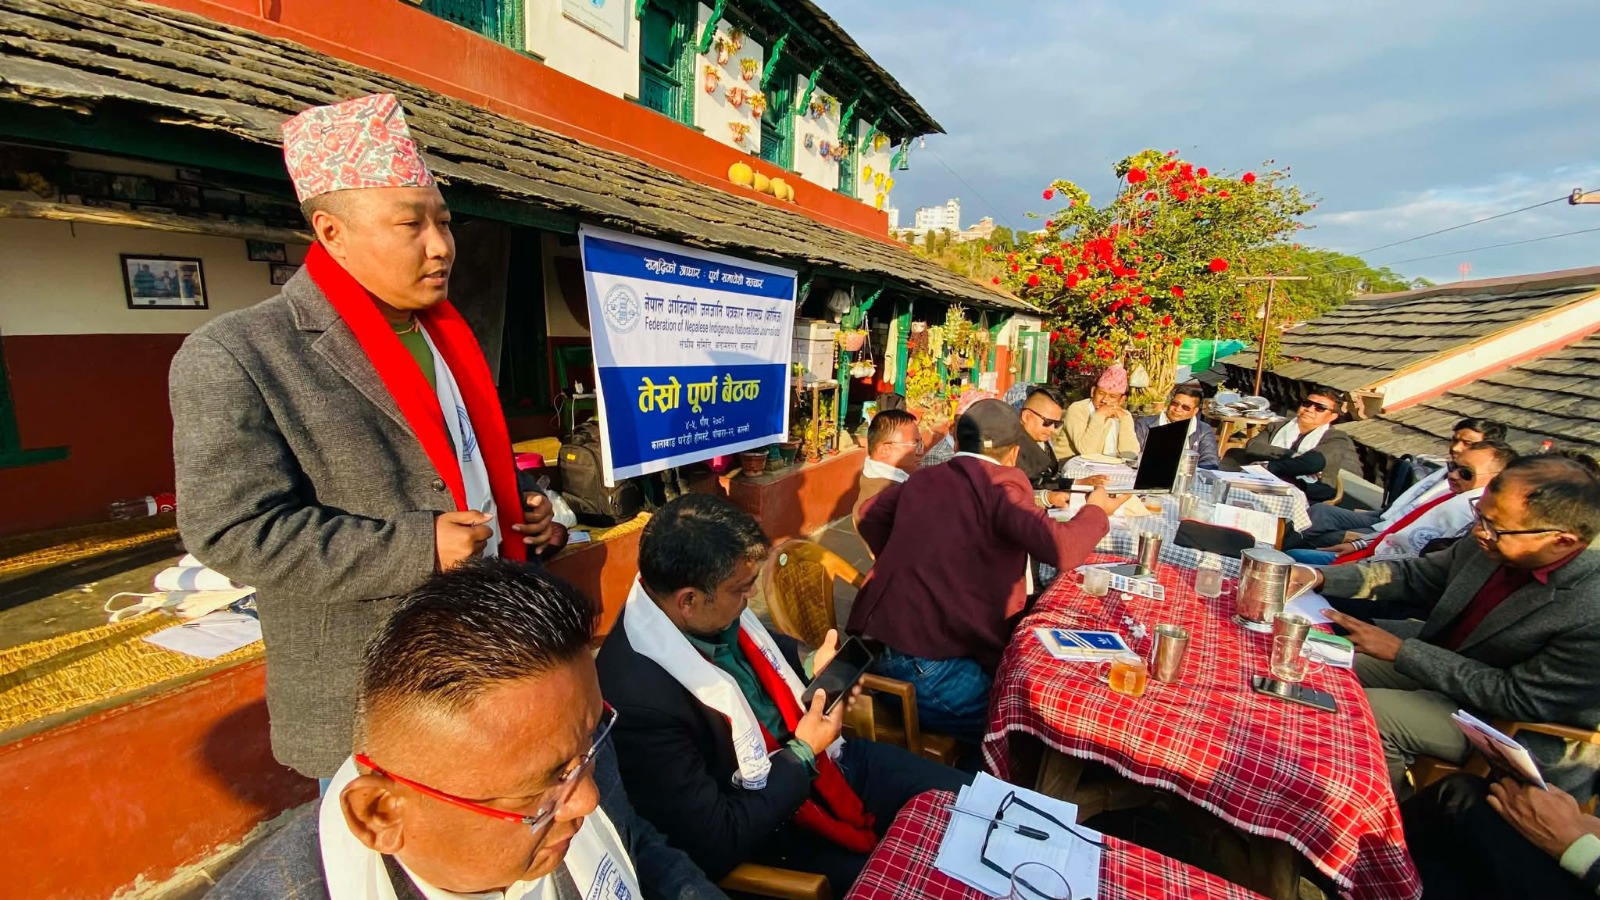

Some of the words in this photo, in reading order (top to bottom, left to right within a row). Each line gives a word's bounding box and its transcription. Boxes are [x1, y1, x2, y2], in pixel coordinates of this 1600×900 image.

[679, 264, 701, 279] आधार
[708, 269, 720, 284] पूर्ण
[644, 292, 664, 315] नेपाल
[668, 296, 698, 318] आदिवासी
[700, 300, 724, 318] जनजाति
[726, 306, 744, 322] पत्रकार
[644, 316, 677, 332] Federation
[678, 320, 684, 332] of
[684, 320, 709, 336] Nepalese
[709, 322, 734, 337] Indigenous
[735, 324, 760, 336] Nationalities
[638, 375, 682, 414] तेस्रो
[686, 375, 718, 414] पूर्ण
[722, 373, 761, 403] बैठक
